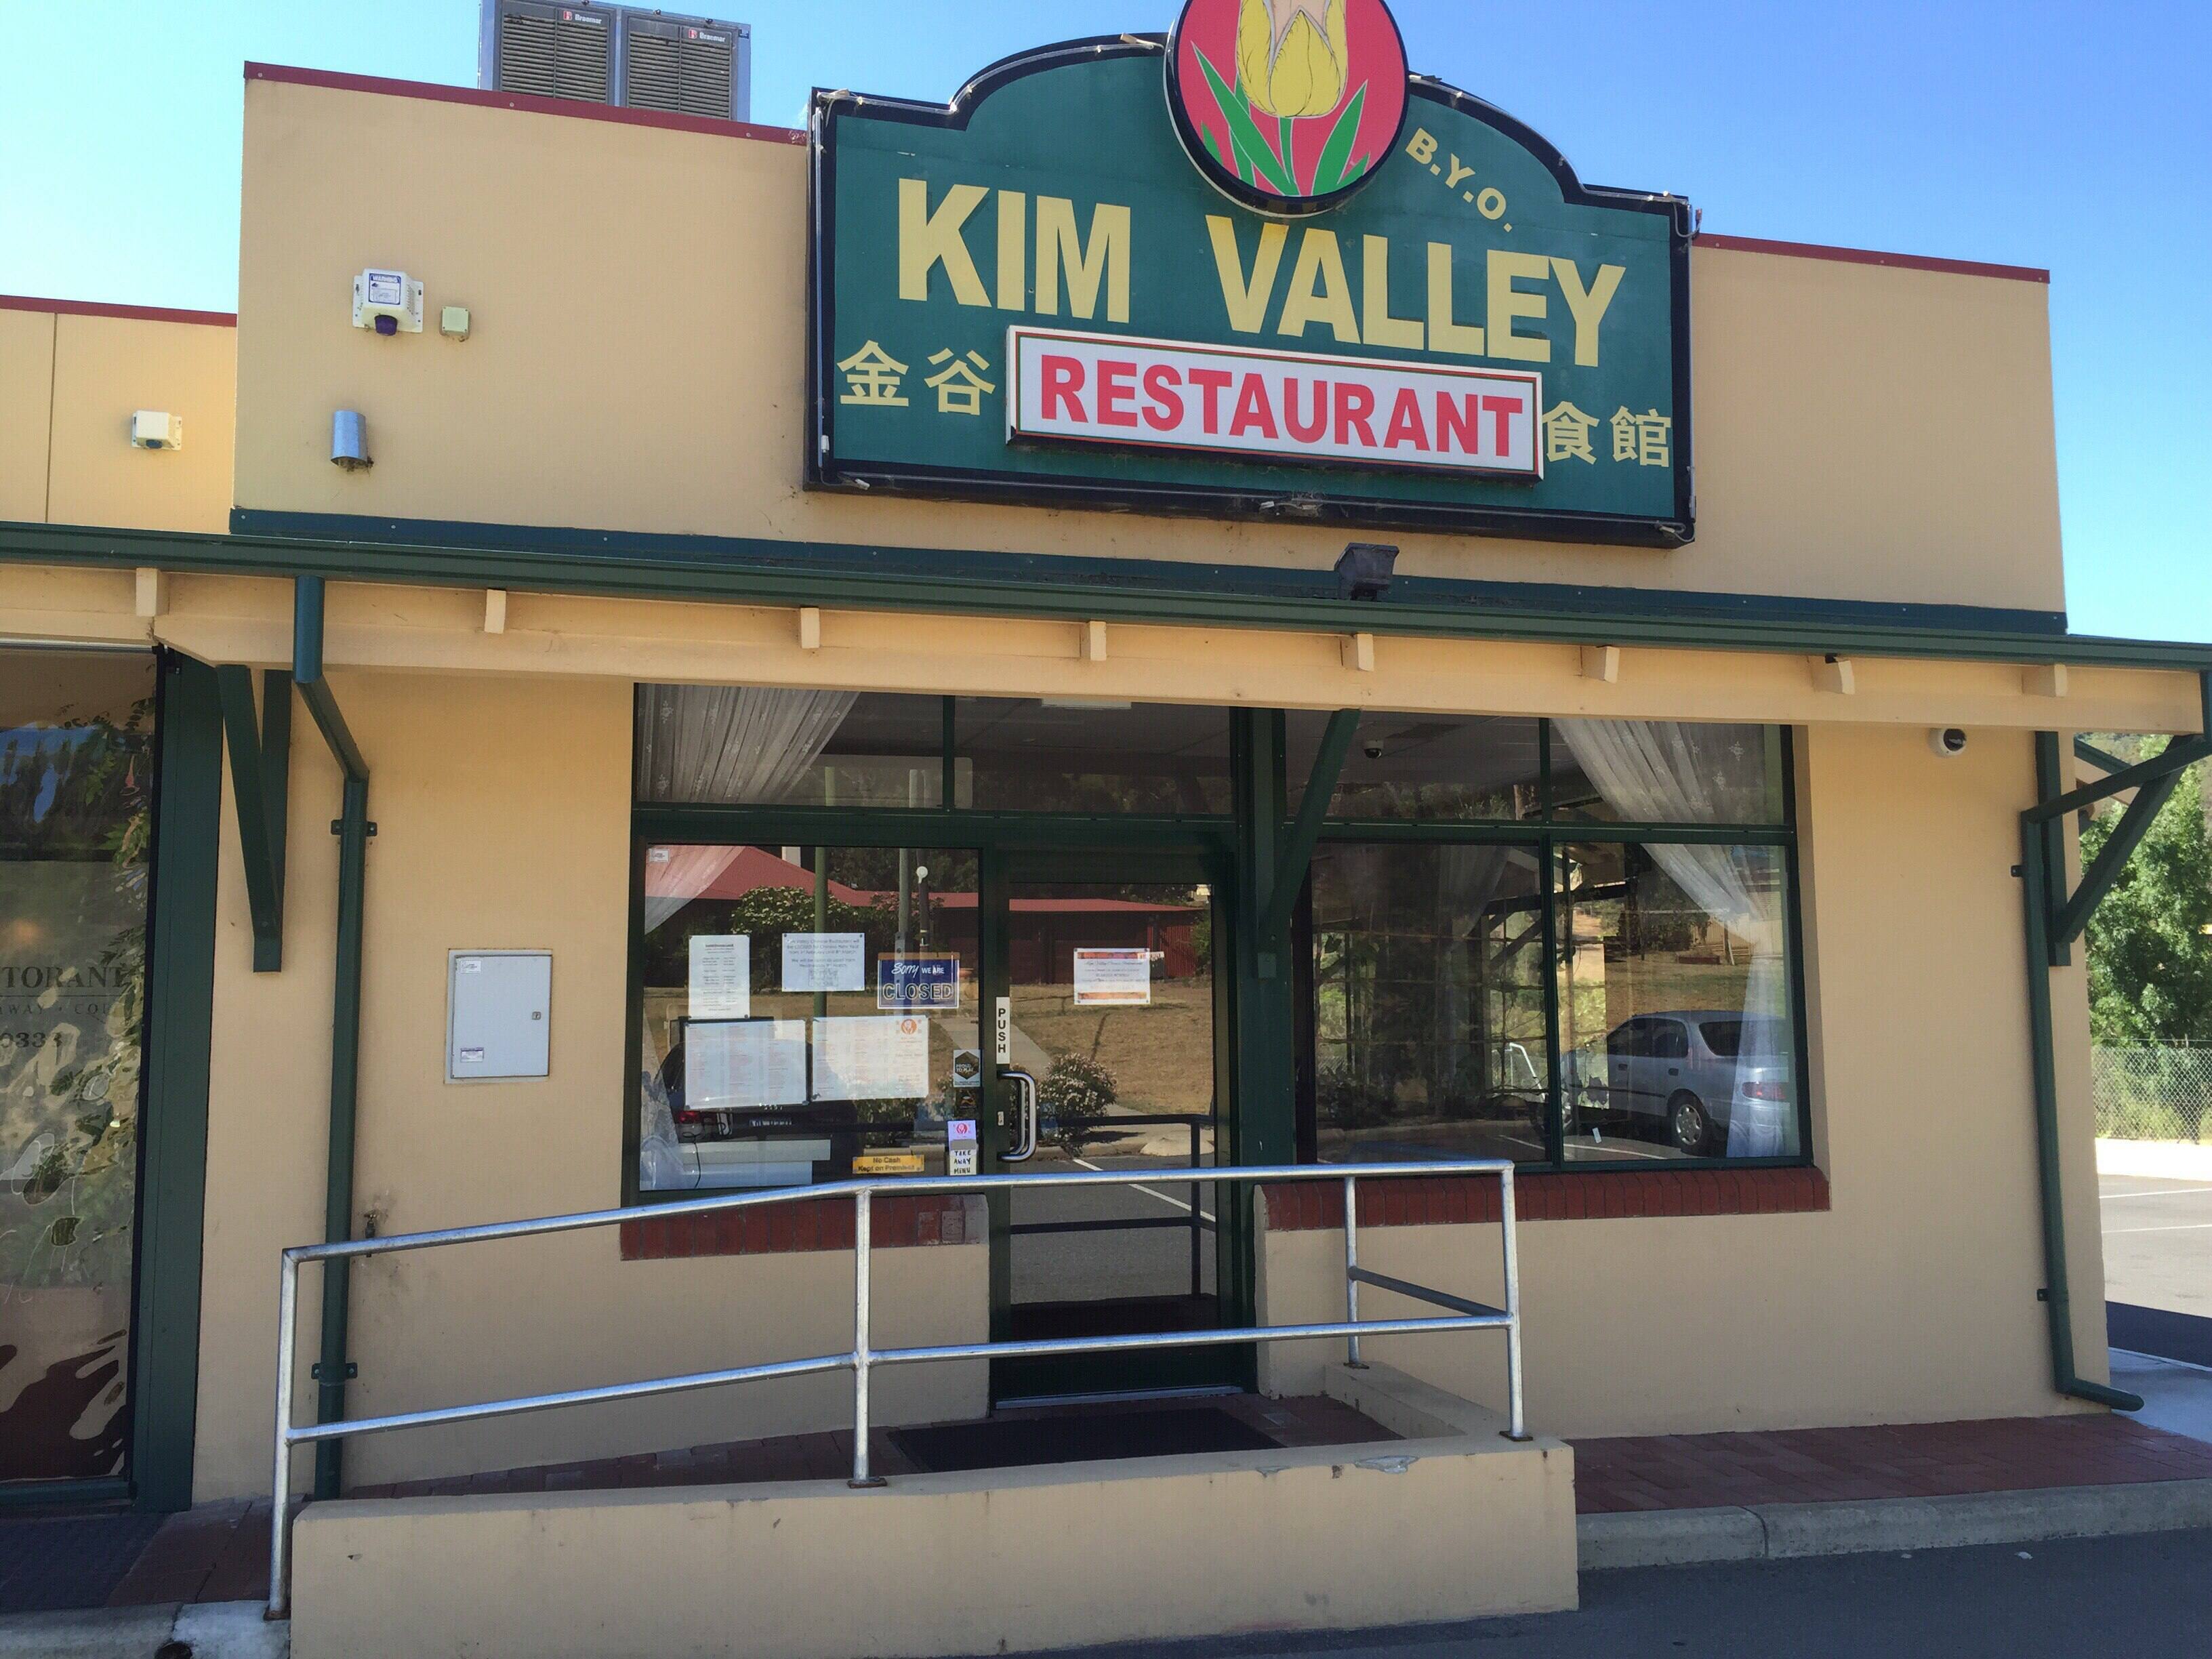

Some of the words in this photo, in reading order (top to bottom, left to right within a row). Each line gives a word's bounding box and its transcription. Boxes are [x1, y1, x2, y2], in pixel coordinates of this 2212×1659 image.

[1406, 127, 1513, 232] B.Y.O.
[899, 178, 1131, 323] KIM
[1206, 214, 1626, 367] VALLEY
[837, 340, 996, 415] 金谷
[1040, 354, 1523, 457] RESTAURANT
[1542, 401, 1671, 468] 食館
[882, 983, 954, 1000] CLOSED
[891, 962, 919, 978] Sorry
[998, 1008, 1006, 1053] PUSH
